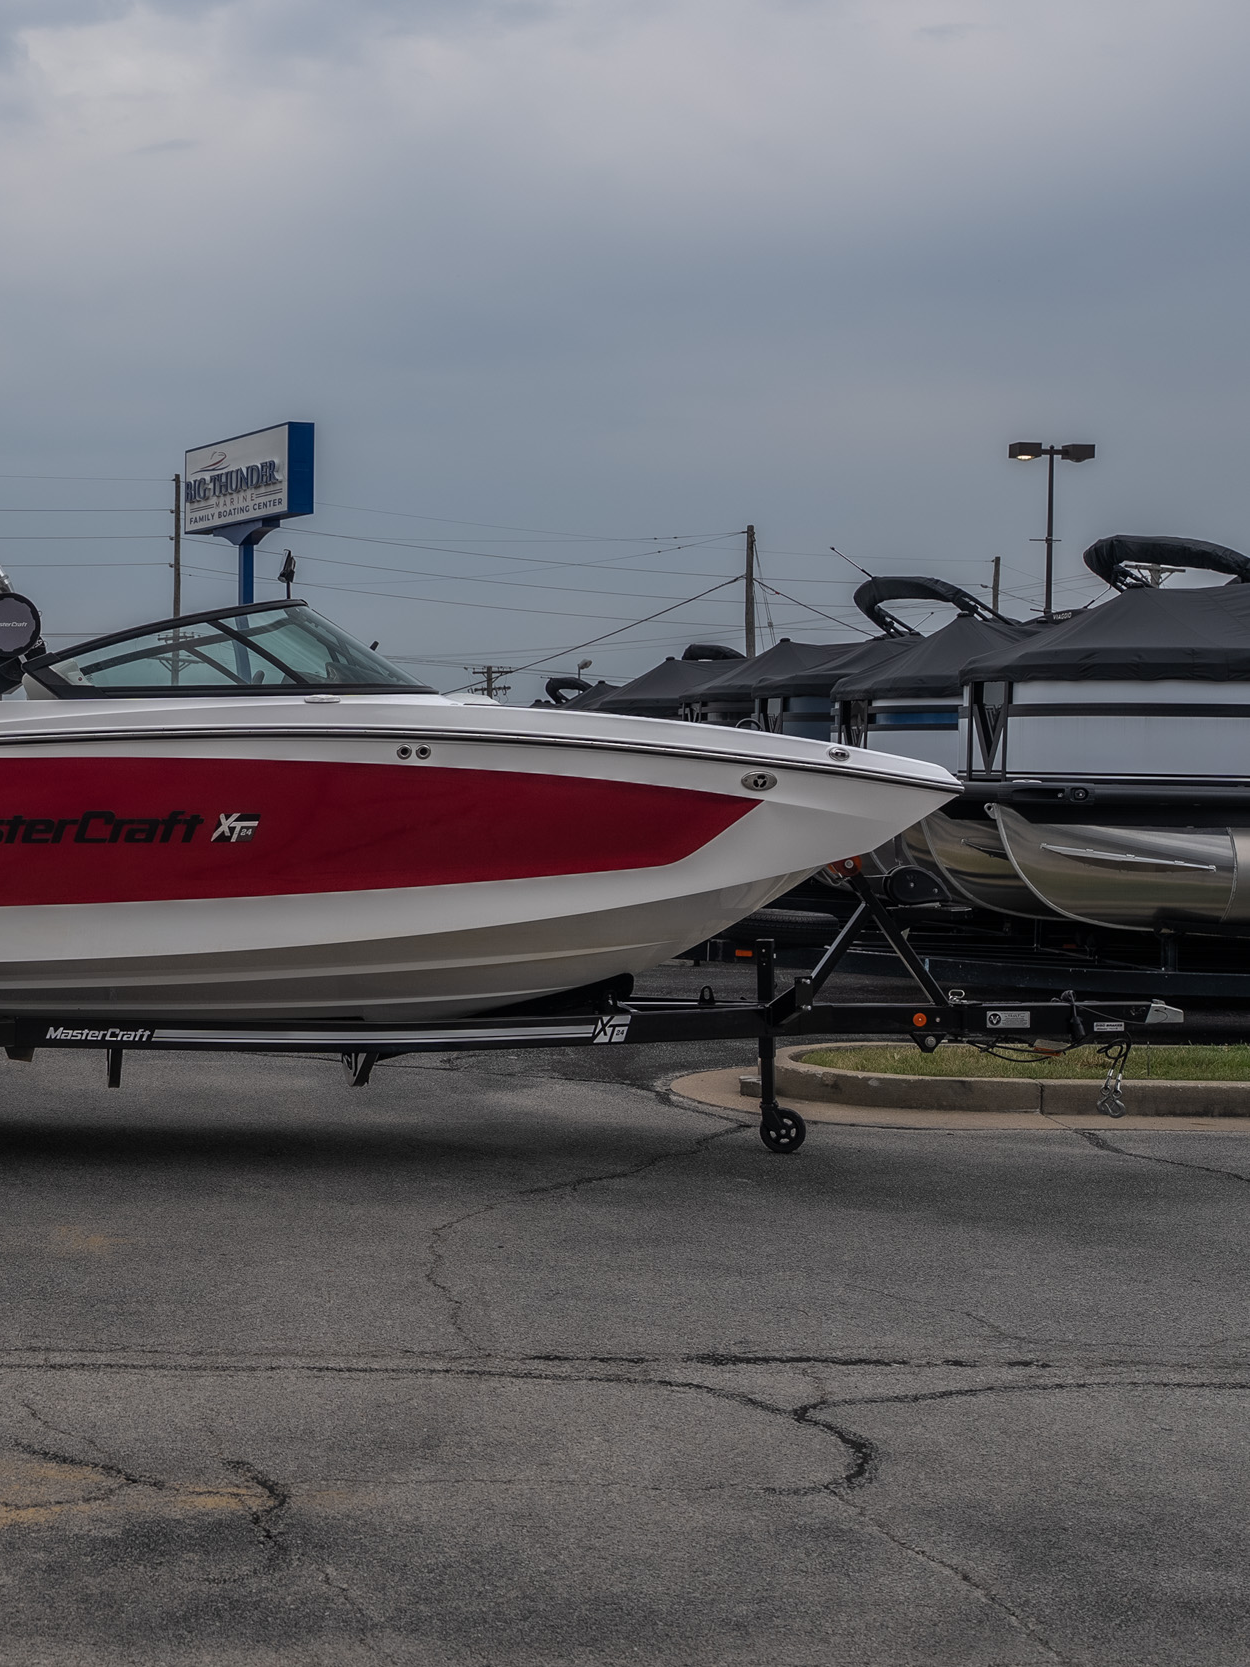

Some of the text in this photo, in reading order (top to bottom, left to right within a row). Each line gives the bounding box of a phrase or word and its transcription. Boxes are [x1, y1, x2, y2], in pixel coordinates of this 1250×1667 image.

[185, 460, 279, 503] BIG THUNDER
[215, 493, 255, 508] MARINE
[189, 498, 283, 525] FAMILY BOATING CENTER
[240, 828, 252, 836] 24
[45, 1026, 151, 1041] MasterCraft
